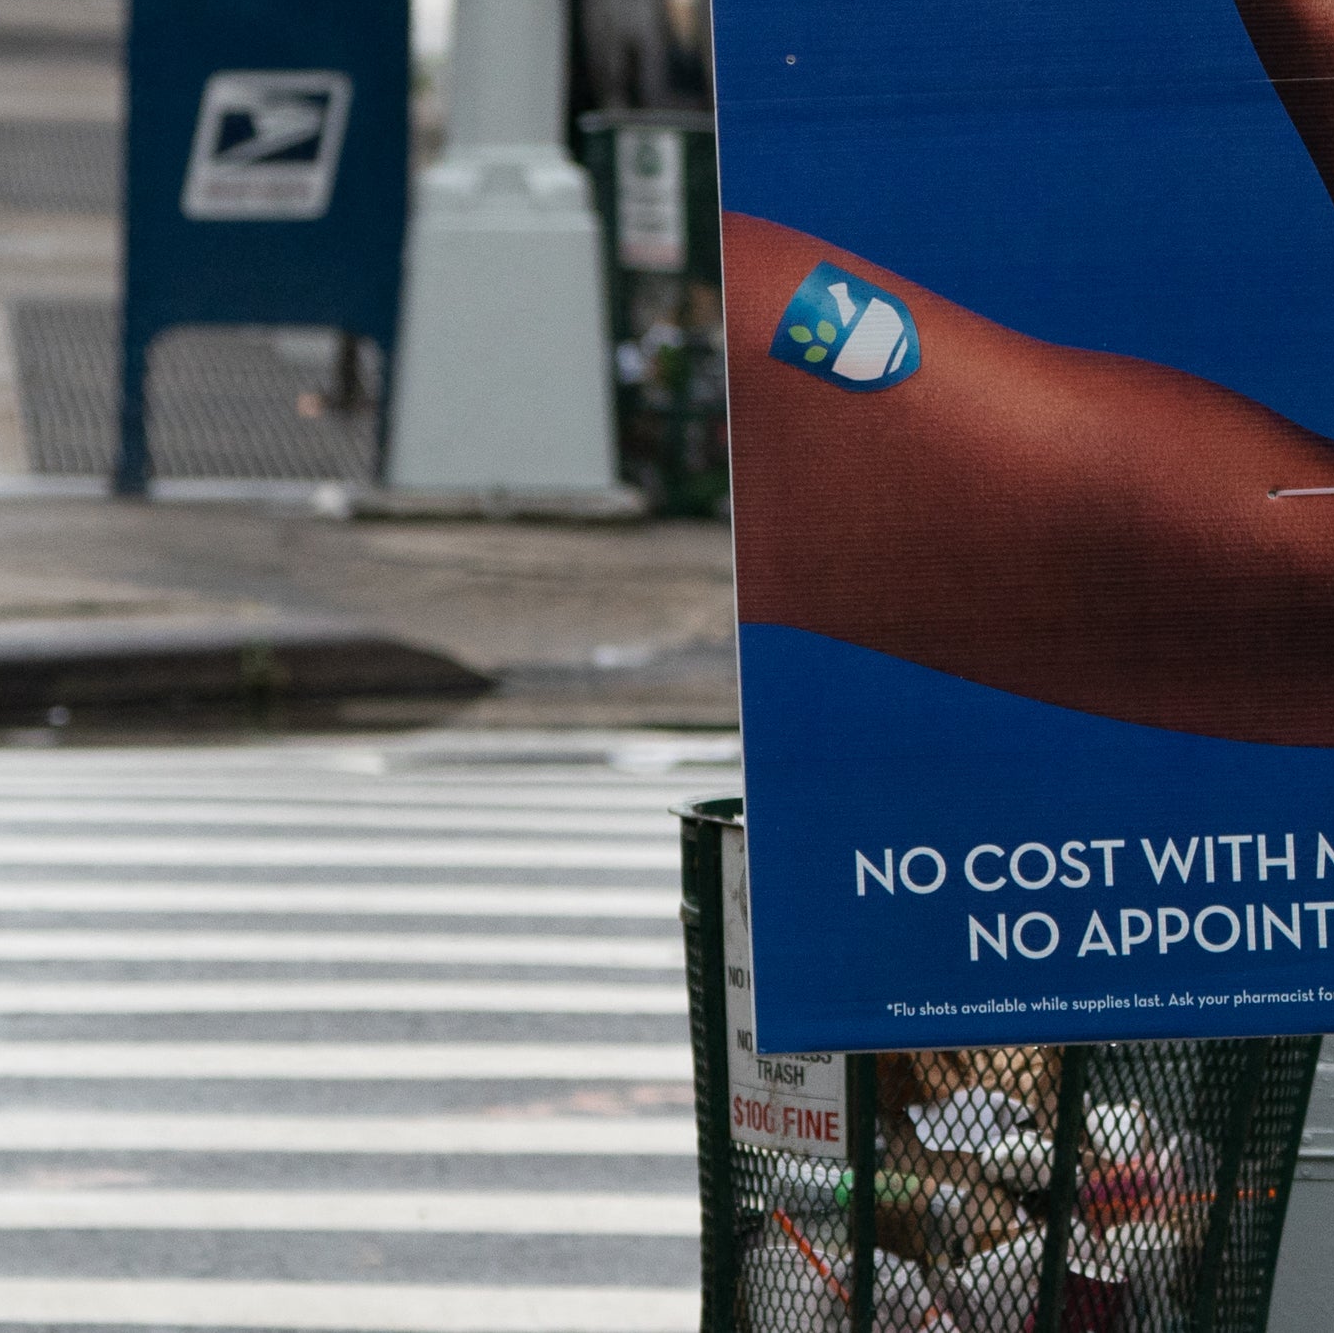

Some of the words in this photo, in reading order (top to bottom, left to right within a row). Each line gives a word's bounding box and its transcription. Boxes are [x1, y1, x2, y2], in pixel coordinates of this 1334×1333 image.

[856, 847, 946, 895] NO
[965, 840, 1124, 891] COST
[1141, 834, 1295, 884] WITH
[969, 912, 1059, 960] NO
[729, 967, 744, 989] NO
[920, 1001, 957, 1016] shots
[961, 999, 1027, 1014] available
[1030, 997, 1068, 1011] while
[1072, 995, 1130, 1013] supplies
[1134, 994, 1165, 1008] last.
[1168, 992, 1194, 1006] Ask
[1198, 995, 1229, 1009] your
[1233, 989, 1314, 1007] pharmacist
[737, 1029, 753, 1052] NO
[756, 1059, 805, 1086] TRASH
[783, 1107, 840, 1143] FINE
